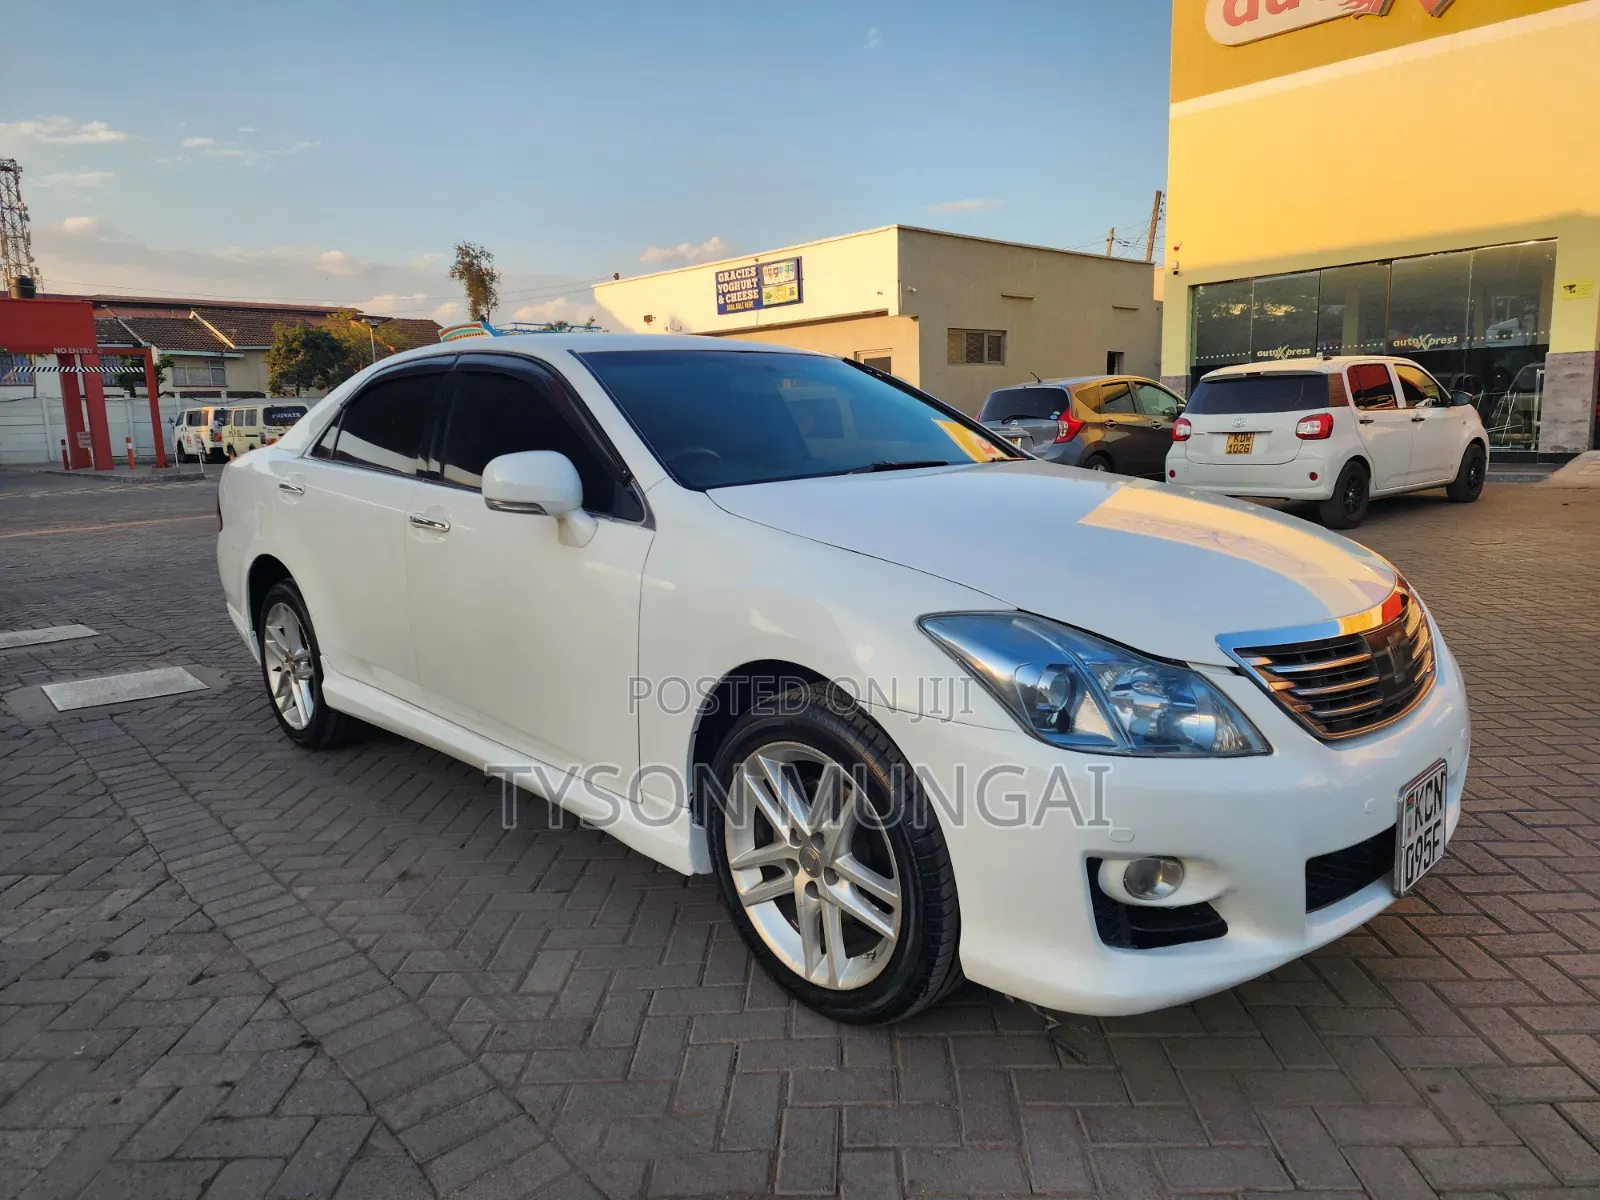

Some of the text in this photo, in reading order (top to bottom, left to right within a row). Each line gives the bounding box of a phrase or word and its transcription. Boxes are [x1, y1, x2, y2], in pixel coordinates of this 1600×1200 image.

[718, 267, 757, 282] GRACIES
[717, 278, 758, 294] YOGHURT
[718, 289, 759, 304] & CHEESE
[1227, 443, 1250, 454] 102G
[1414, 770, 1445, 832] KCN
[1405, 818, 1442, 888] 095F
